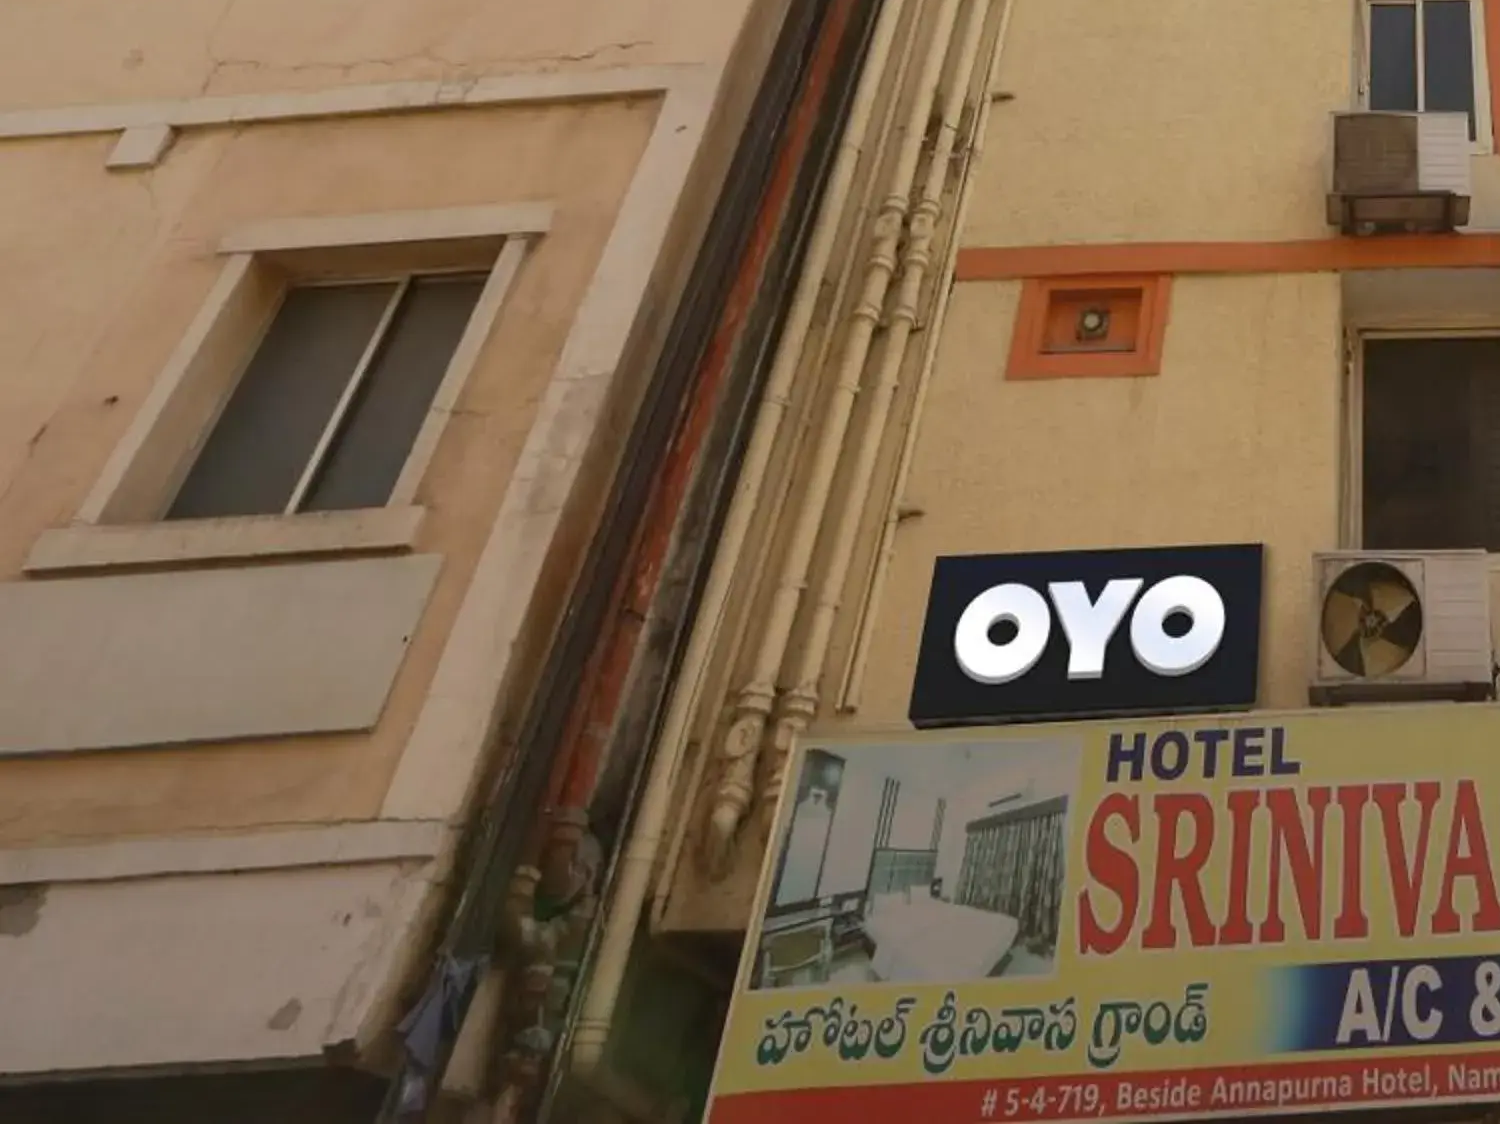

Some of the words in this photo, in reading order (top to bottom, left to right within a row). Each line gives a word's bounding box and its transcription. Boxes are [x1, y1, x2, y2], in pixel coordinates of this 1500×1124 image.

[954, 574, 1226, 684] OYO
[1105, 727, 1301, 783] HOTEL
[1336, 963, 1444, 1045] A/C
[981, 1095, 996, 1116] #
[1004, 1086, 1105, 1116] 5-4-719,
[1116, 1082, 1200, 1110] Beside
[1211, 1076, 1352, 1109] Annapurna
[1362, 1066, 1437, 1096] Hotel,
